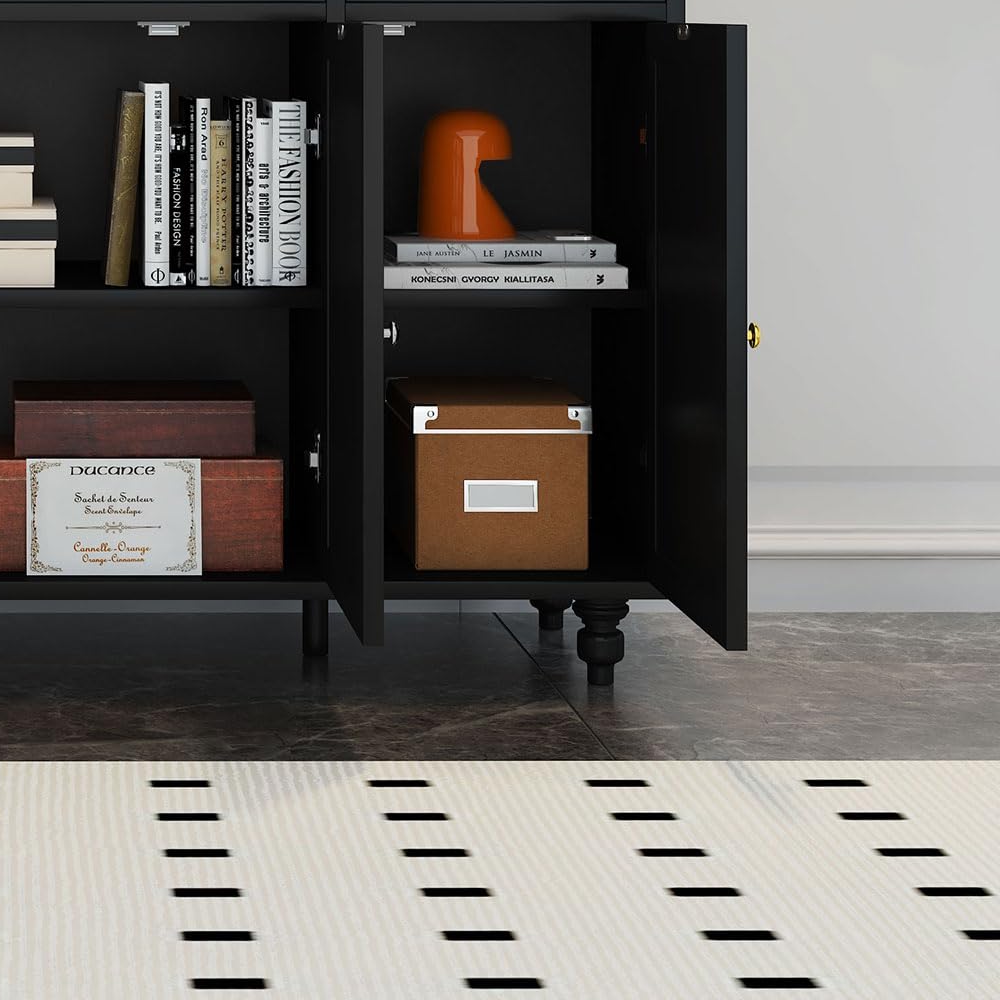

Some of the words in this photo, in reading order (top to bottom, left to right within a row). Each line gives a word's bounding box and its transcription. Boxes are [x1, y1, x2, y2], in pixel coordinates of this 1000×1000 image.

[200, 107, 209, 130] Ron
[278, 105, 301, 143] THE
[200, 134, 209, 161] Arad
[258, 163, 270, 180] arts
[172, 167, 182, 209] FASHION
[278, 147, 301, 225] FASHION
[172, 211, 182, 247] DESIGN
[258, 193, 271, 243] architecture
[278, 231, 301, 281] BOOK
[483, 249, 495, 258] LE
[503, 249, 543, 259] JASMIN
[410, 275, 457, 283] KONECSNI
[461, 275, 500, 283] GYORGY
[503, 275, 555, 283] KIALLITASA
[73, 491, 105, 503] Sachet
[107, 495, 118, 503] de
[118, 491, 155, 503] Senteur
[84, 505, 106, 515] Scent
